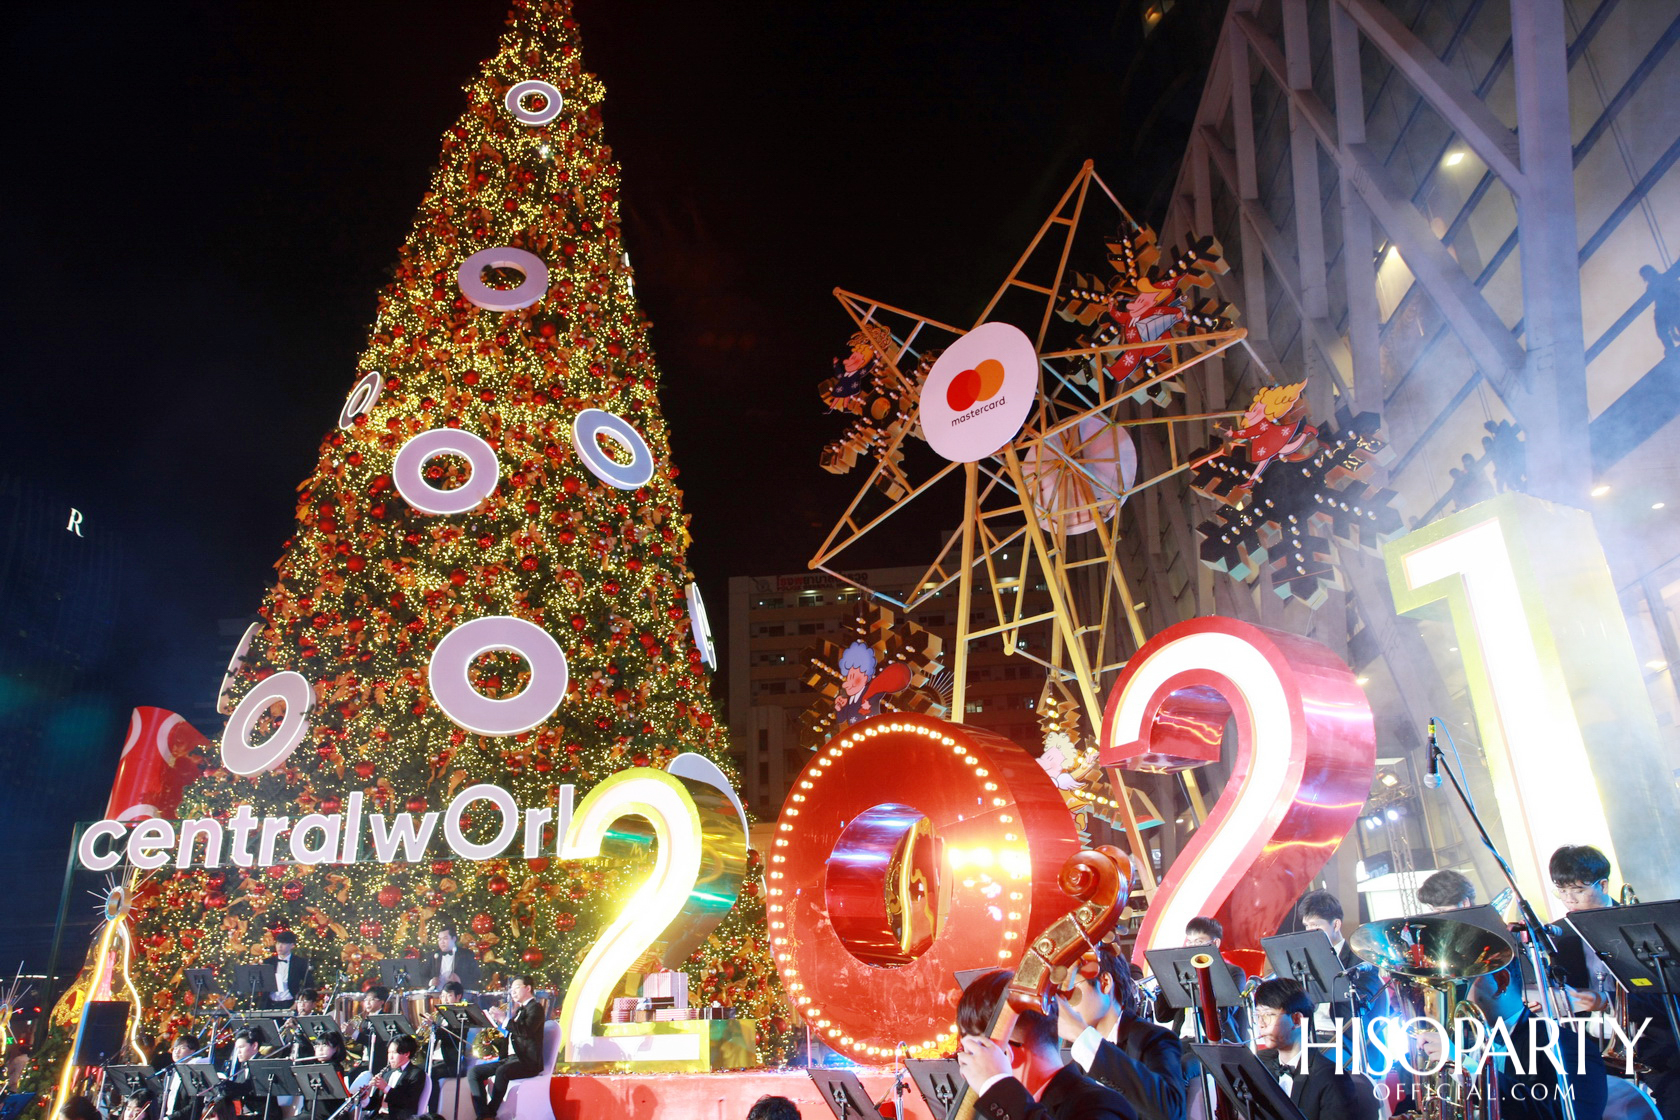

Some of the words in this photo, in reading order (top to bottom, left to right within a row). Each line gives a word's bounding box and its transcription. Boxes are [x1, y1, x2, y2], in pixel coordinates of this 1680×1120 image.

[951, 396, 1006, 427] mastercard
[66, 507, 85, 538] R
[78, 783, 575, 871] centralwOrl
